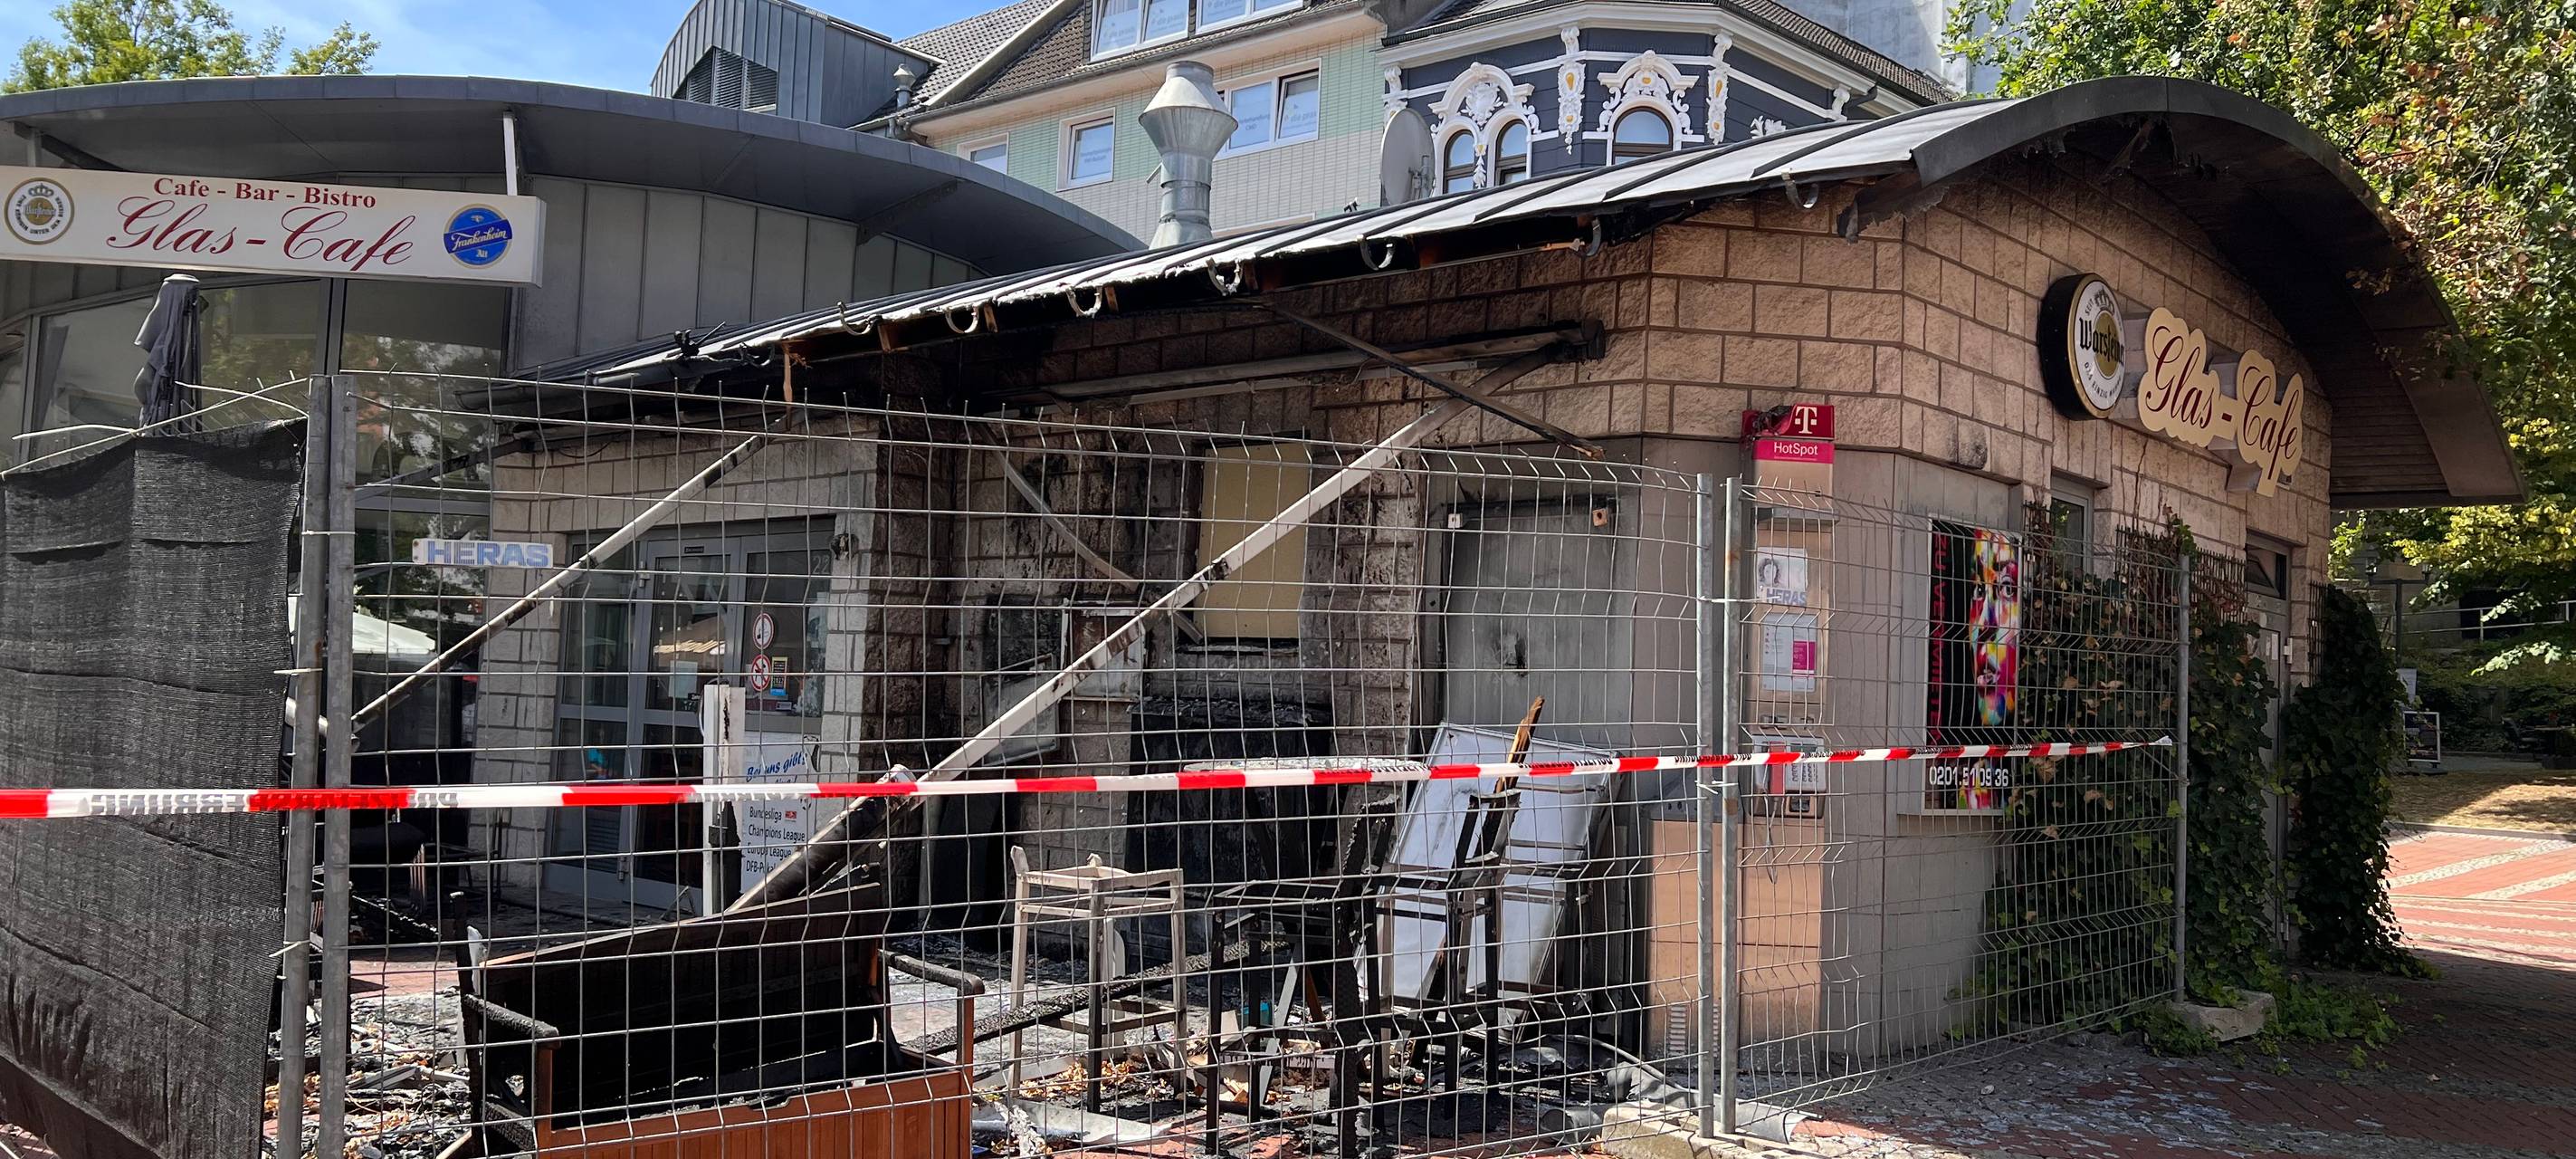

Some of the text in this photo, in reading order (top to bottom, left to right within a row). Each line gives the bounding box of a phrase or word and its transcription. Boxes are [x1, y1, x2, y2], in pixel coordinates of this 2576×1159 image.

[153, 177, 209, 199] Cafe
[235, 182, 279, 202] Bar
[304, 187, 377, 209] Bistro
[451, 226, 508, 251] Frankenheim
[1773, 442, 1818, 457] HotSpot
[427, 541, 549, 568] HERAS
[1766, 588, 1807, 606] HERAS
[749, 806, 782, 823] Bundesliga
[749, 824, 806, 844] Champions League
